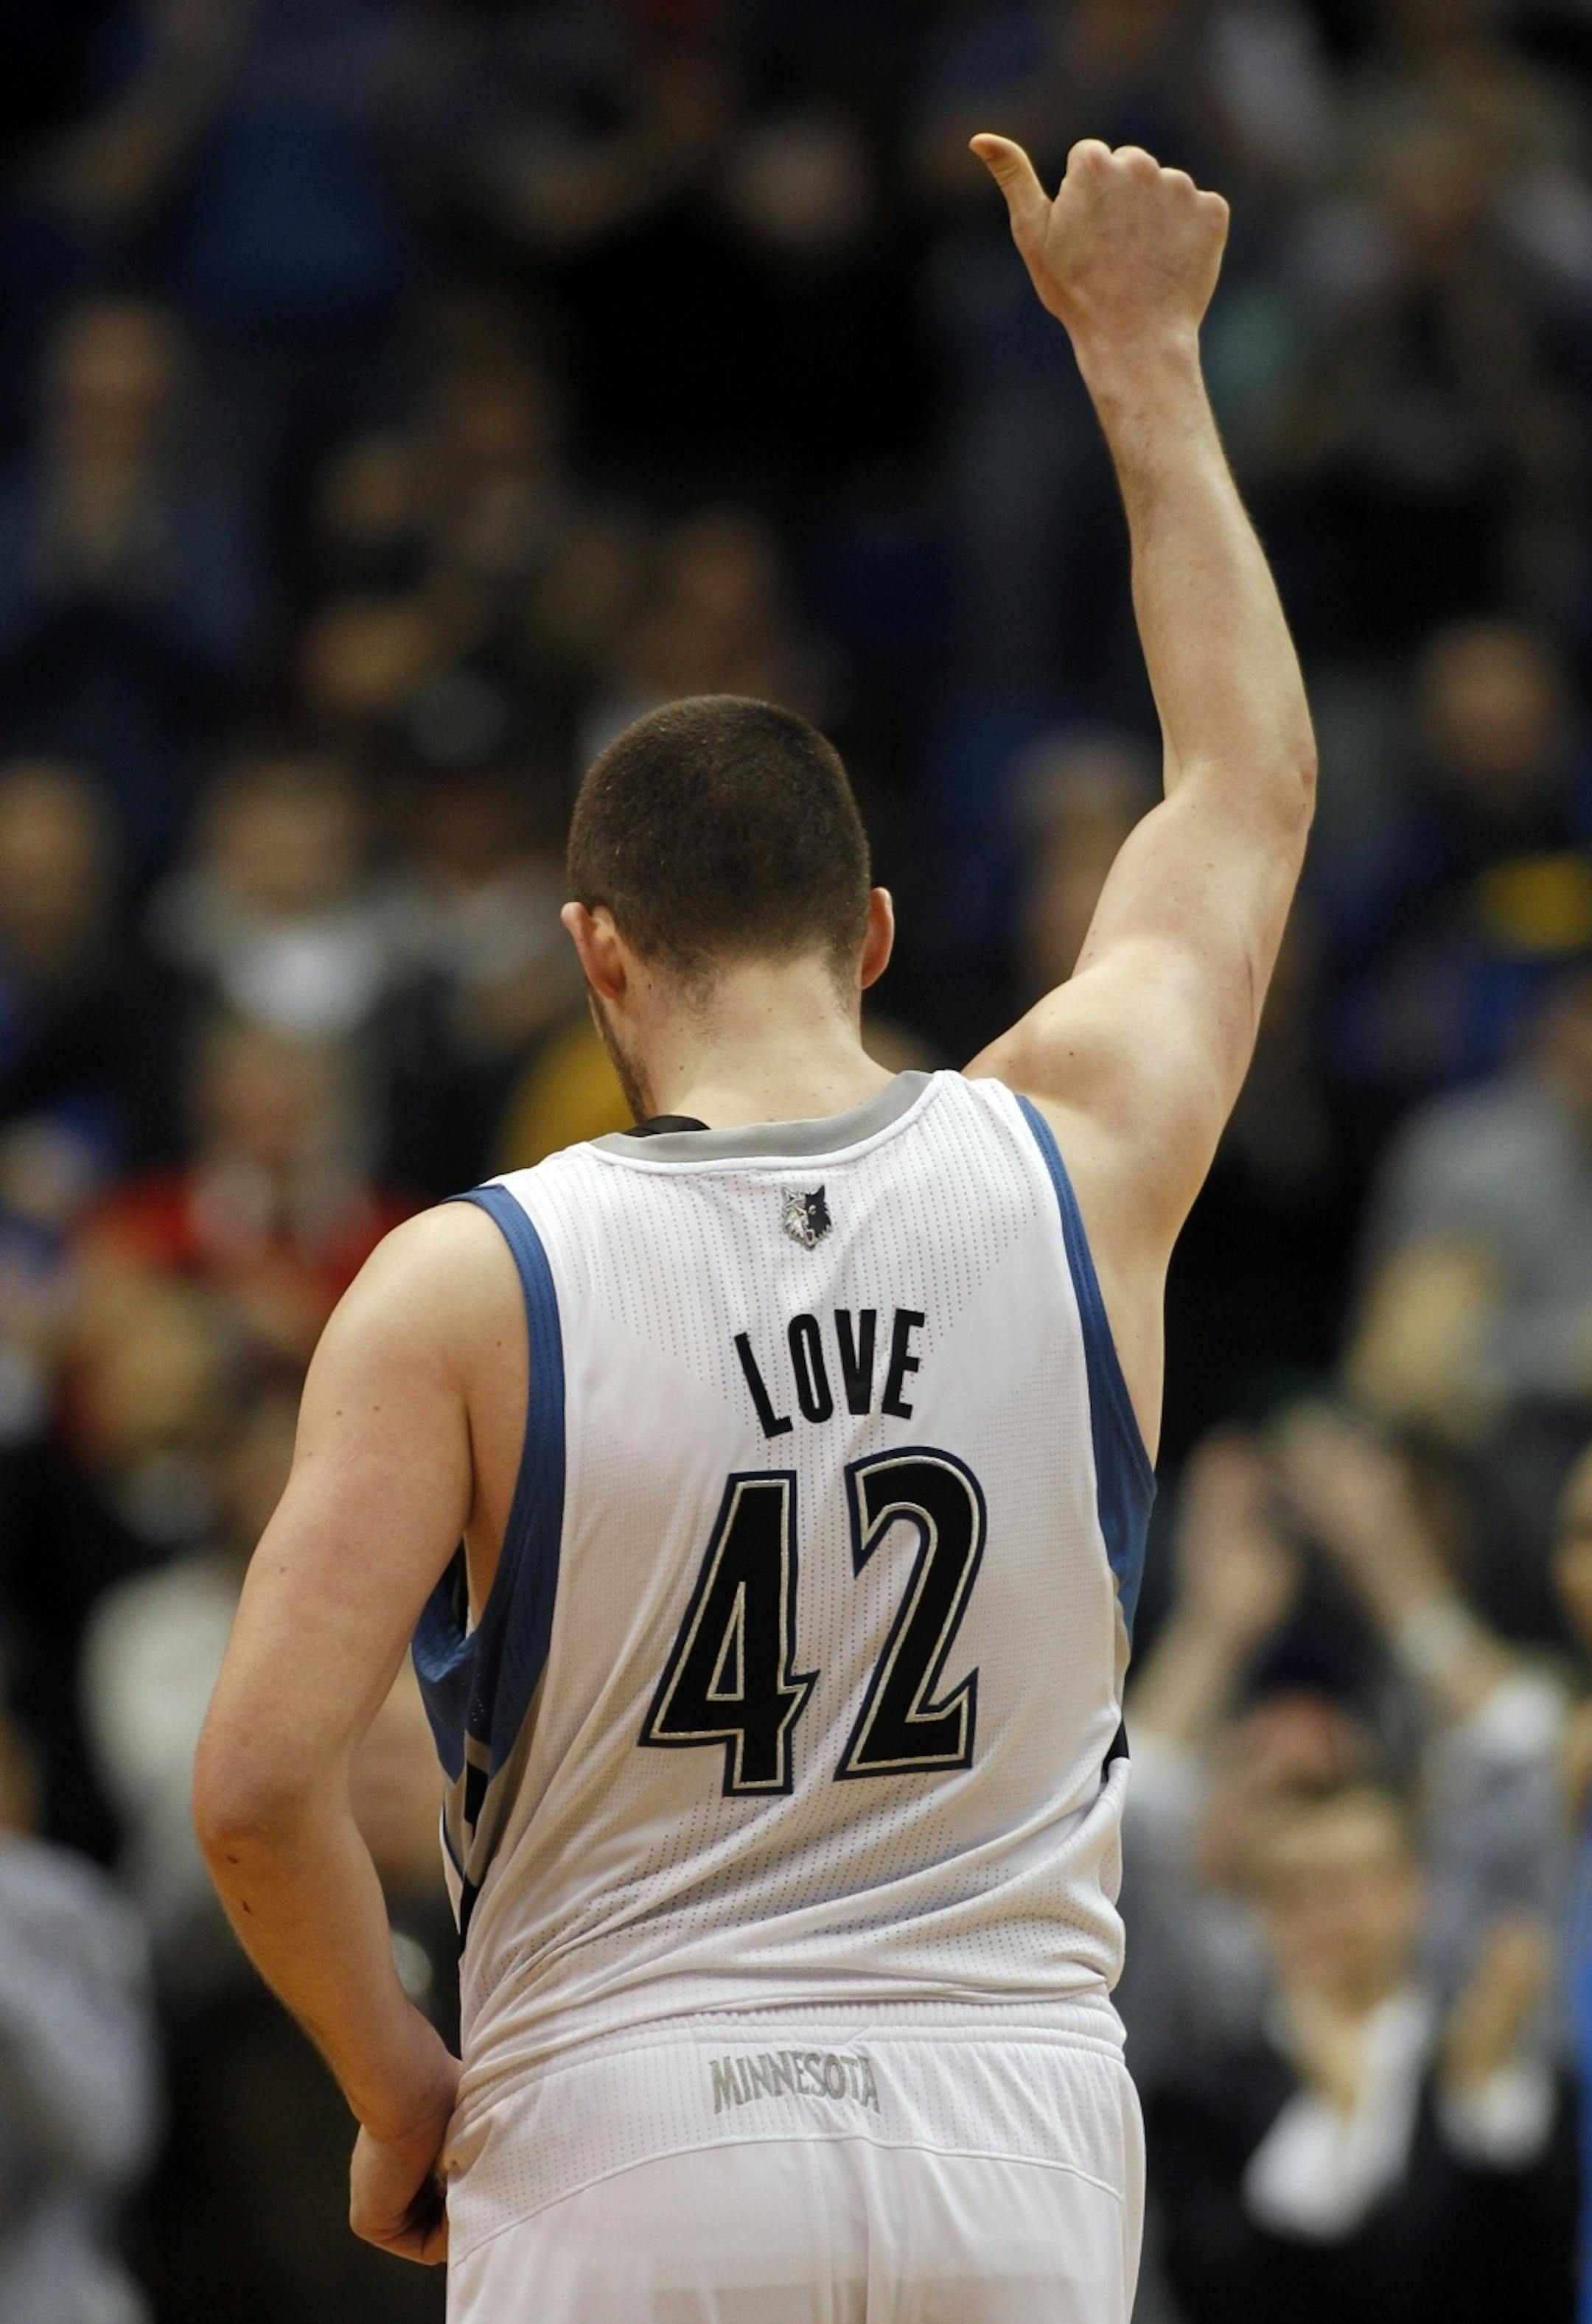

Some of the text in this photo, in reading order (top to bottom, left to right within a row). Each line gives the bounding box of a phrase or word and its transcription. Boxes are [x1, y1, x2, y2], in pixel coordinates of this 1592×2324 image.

[735, 1309, 925, 1438] LOVE
[638, 1446, 987, 1796] 42
[709, 2050, 880, 2114] MINNESOTA
